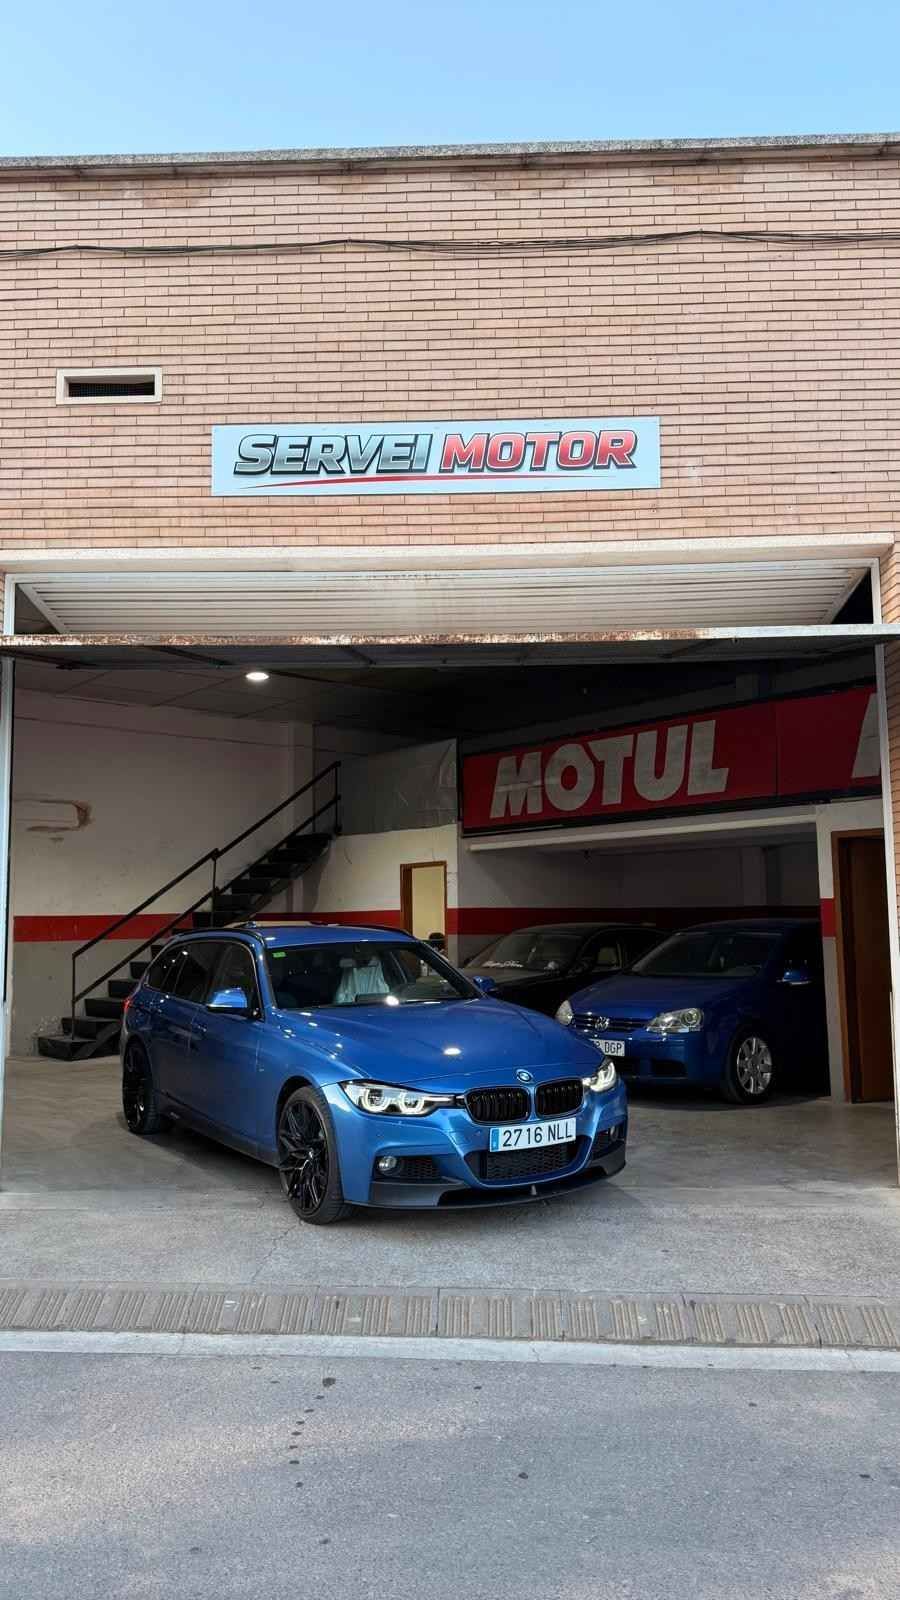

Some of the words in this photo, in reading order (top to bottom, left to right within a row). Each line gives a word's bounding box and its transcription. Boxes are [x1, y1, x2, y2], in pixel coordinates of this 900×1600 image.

[233, 433, 433, 475] SERVEI
[438, 429, 638, 474] MOTOR
[489, 719, 729, 819] MOTUL
[503, 1127, 543, 1147] 2716
[548, 1121, 573, 1142] NLL
